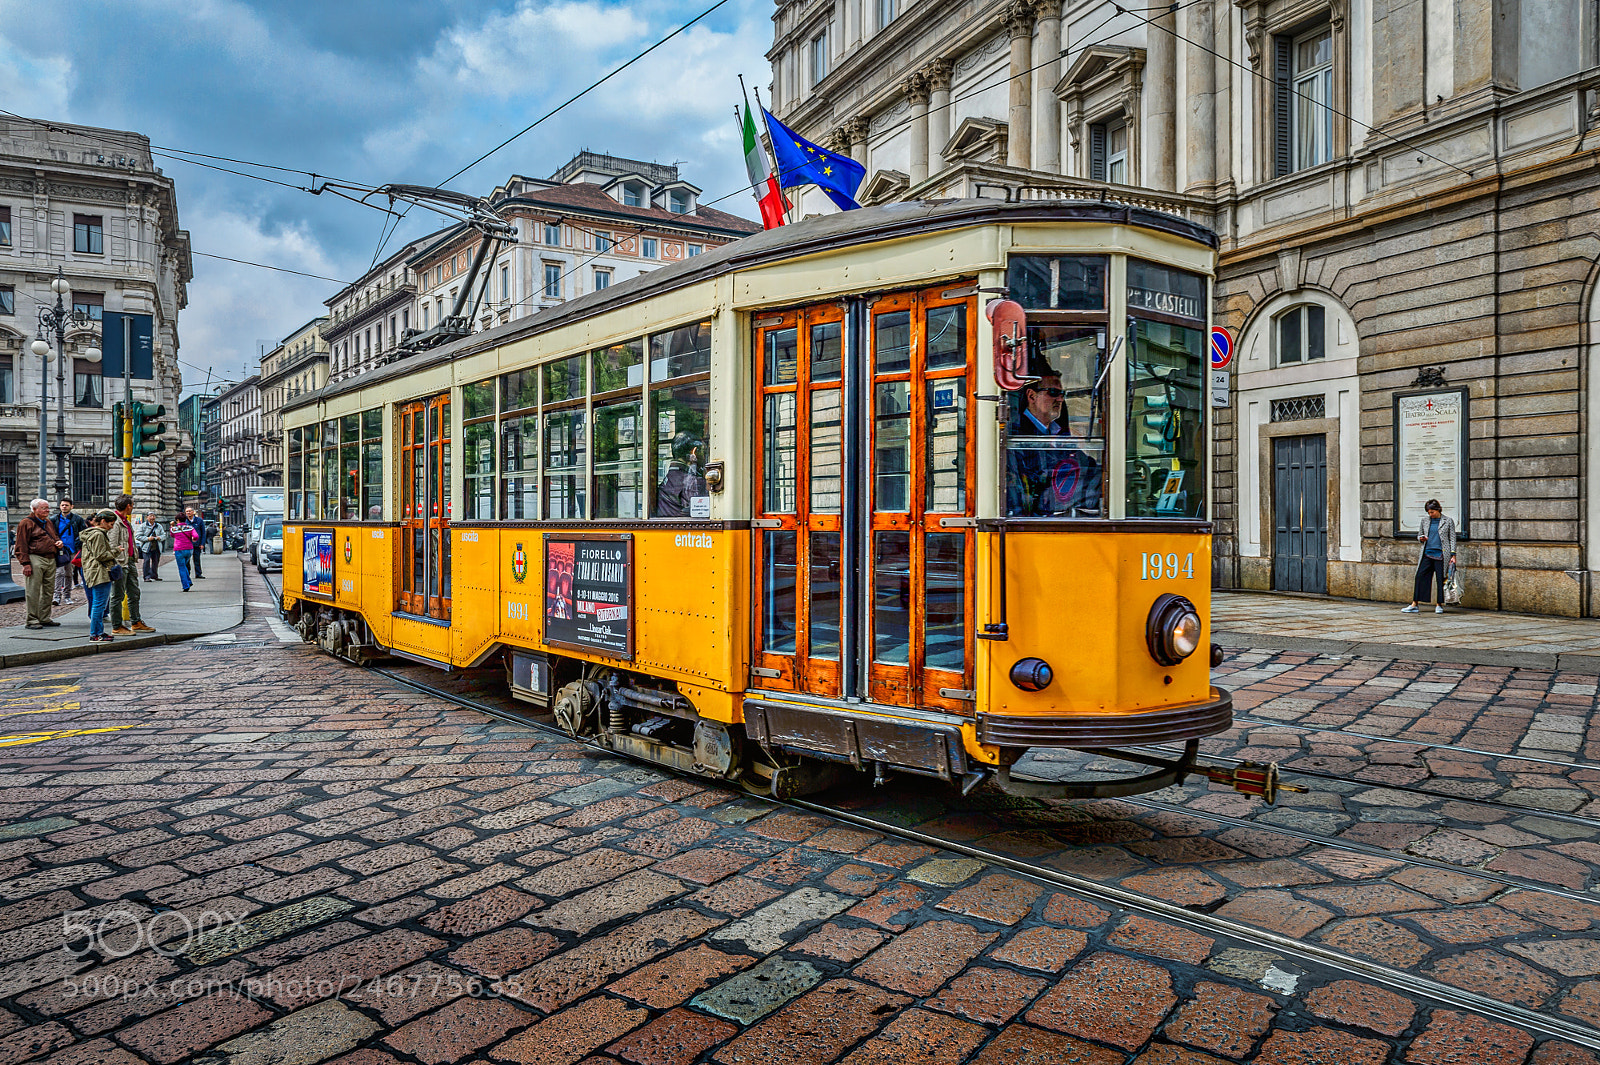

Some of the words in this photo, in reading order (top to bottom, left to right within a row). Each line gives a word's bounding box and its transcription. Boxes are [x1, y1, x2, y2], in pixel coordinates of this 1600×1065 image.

[1155, 292, 1198, 317] CASTELLI
[1434, 407, 1457, 416] SCALA
[1168, 479, 1177, 493] 2
[1163, 495, 1171, 509] 1
[461, 530, 479, 542] uscita
[675, 532, 712, 548] entrata
[581, 549, 622, 560] FIORELLO
[1140, 552, 1194, 580] 1994
[608, 592, 619, 603] 2016
[507, 601, 529, 621] 1994
[577, 601, 595, 613] MILANO
